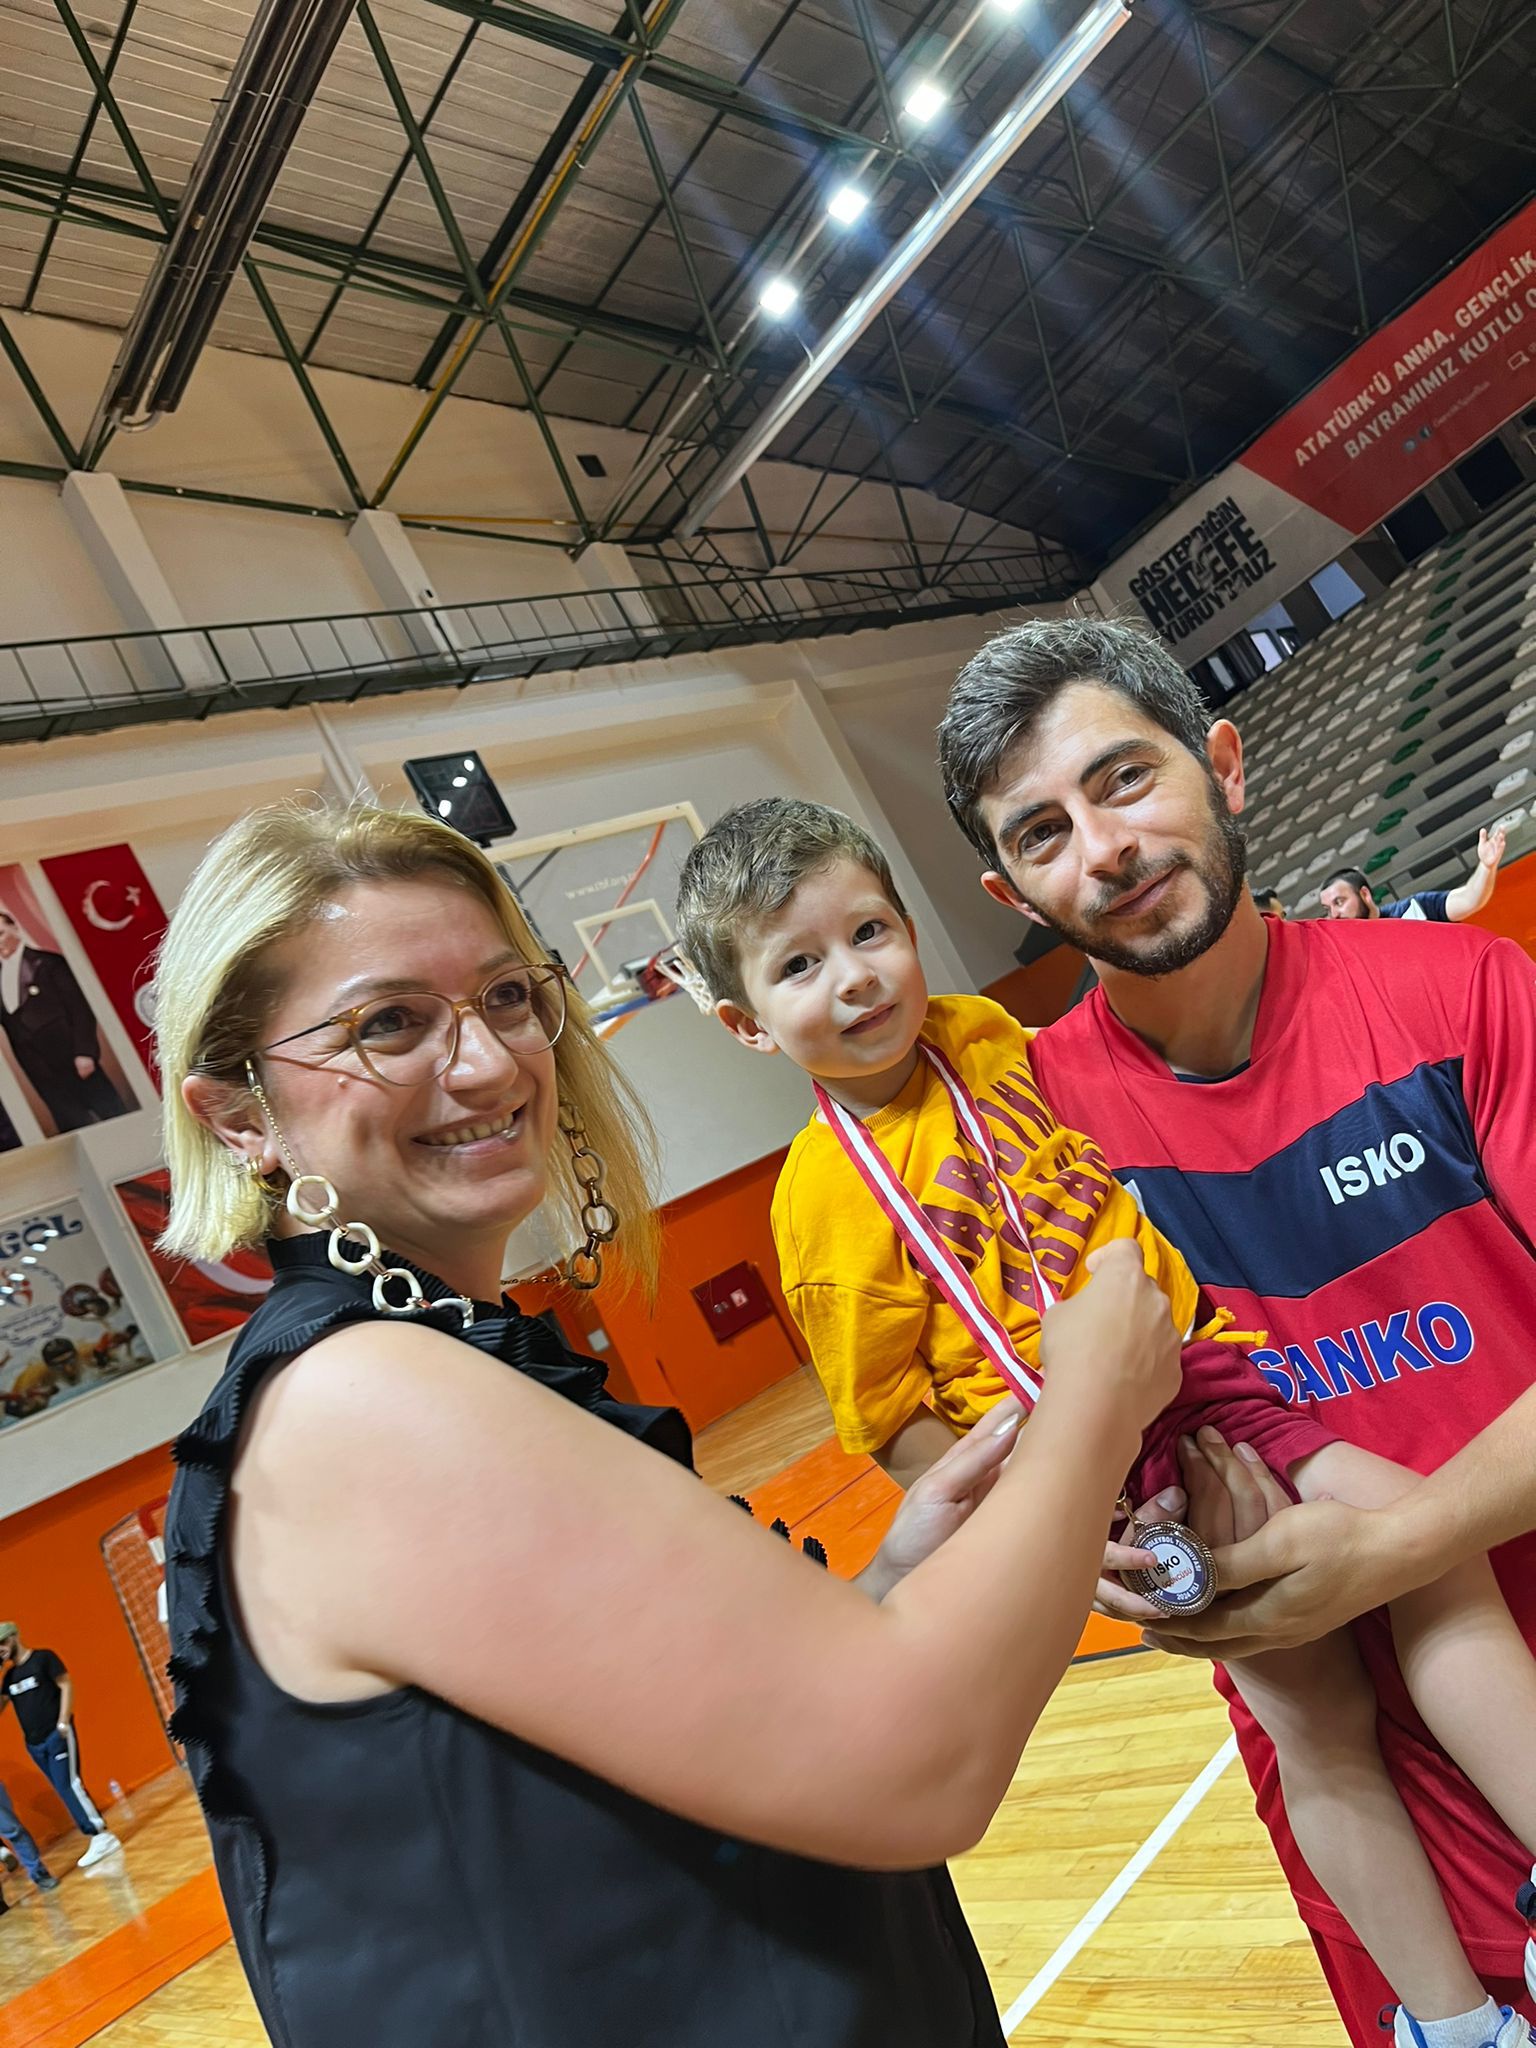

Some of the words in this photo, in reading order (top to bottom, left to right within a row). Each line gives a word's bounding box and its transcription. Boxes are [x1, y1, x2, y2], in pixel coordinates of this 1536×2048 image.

[1295, 371, 1392, 466] ATATÜRK'Ü
[1393, 329, 1455, 381] ANMA,
[1455, 250, 1536, 328] GENÇLİK
[1344, 357, 1460, 459] BAYRAMIMIZ
[1458, 302, 1525, 364] KUTLU
[1139, 515, 1264, 630] HEDEFE
[1319, 1132, 1426, 1205] ISKO
[1248, 1301, 1474, 1404] SANKO
[1145, 1536, 1175, 1549] VOLEYBOL
[1153, 1555, 1180, 1576] ISKO
